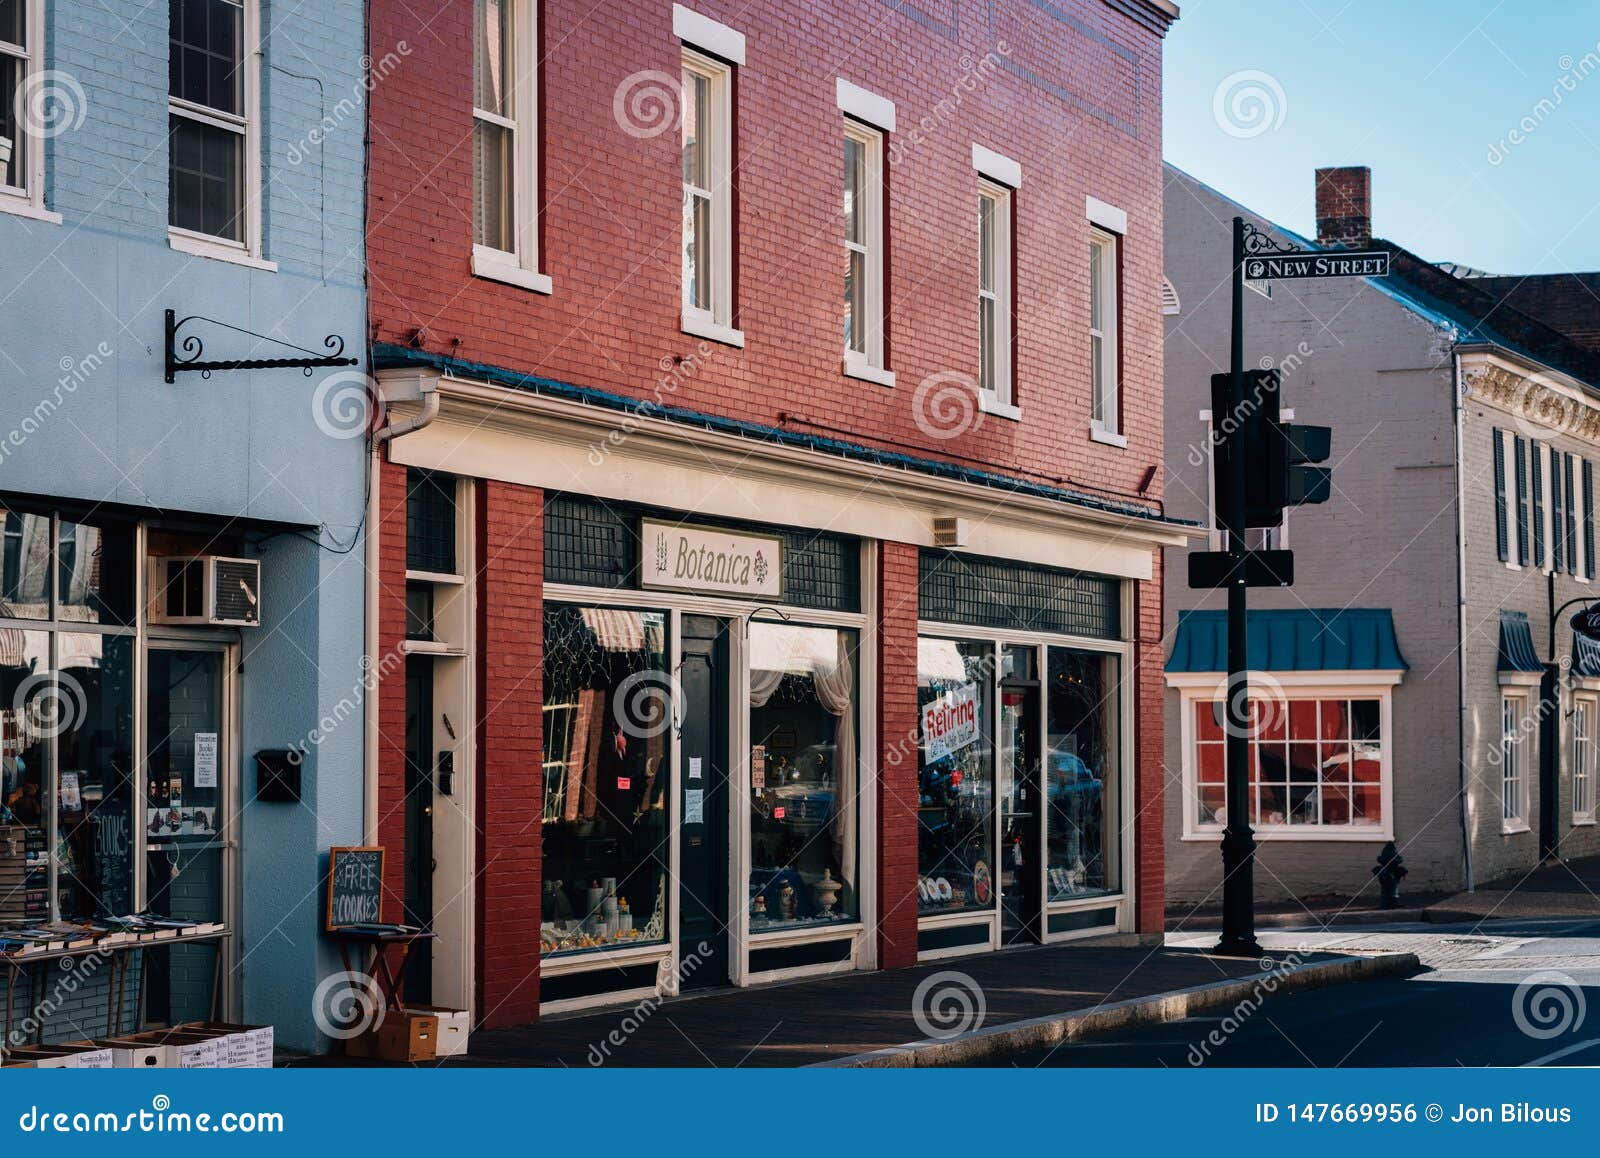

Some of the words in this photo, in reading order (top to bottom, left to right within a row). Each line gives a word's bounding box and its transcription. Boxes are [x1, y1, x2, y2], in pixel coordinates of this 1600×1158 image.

[1268, 260, 1310, 277] NEW
[1315, 258, 1385, 275] STREET
[674, 536, 750, 585] Botanica
[927, 699, 975, 740] Retiring
[344, 863, 375, 890] FREE
[338, 894, 379, 922] COOKIES
